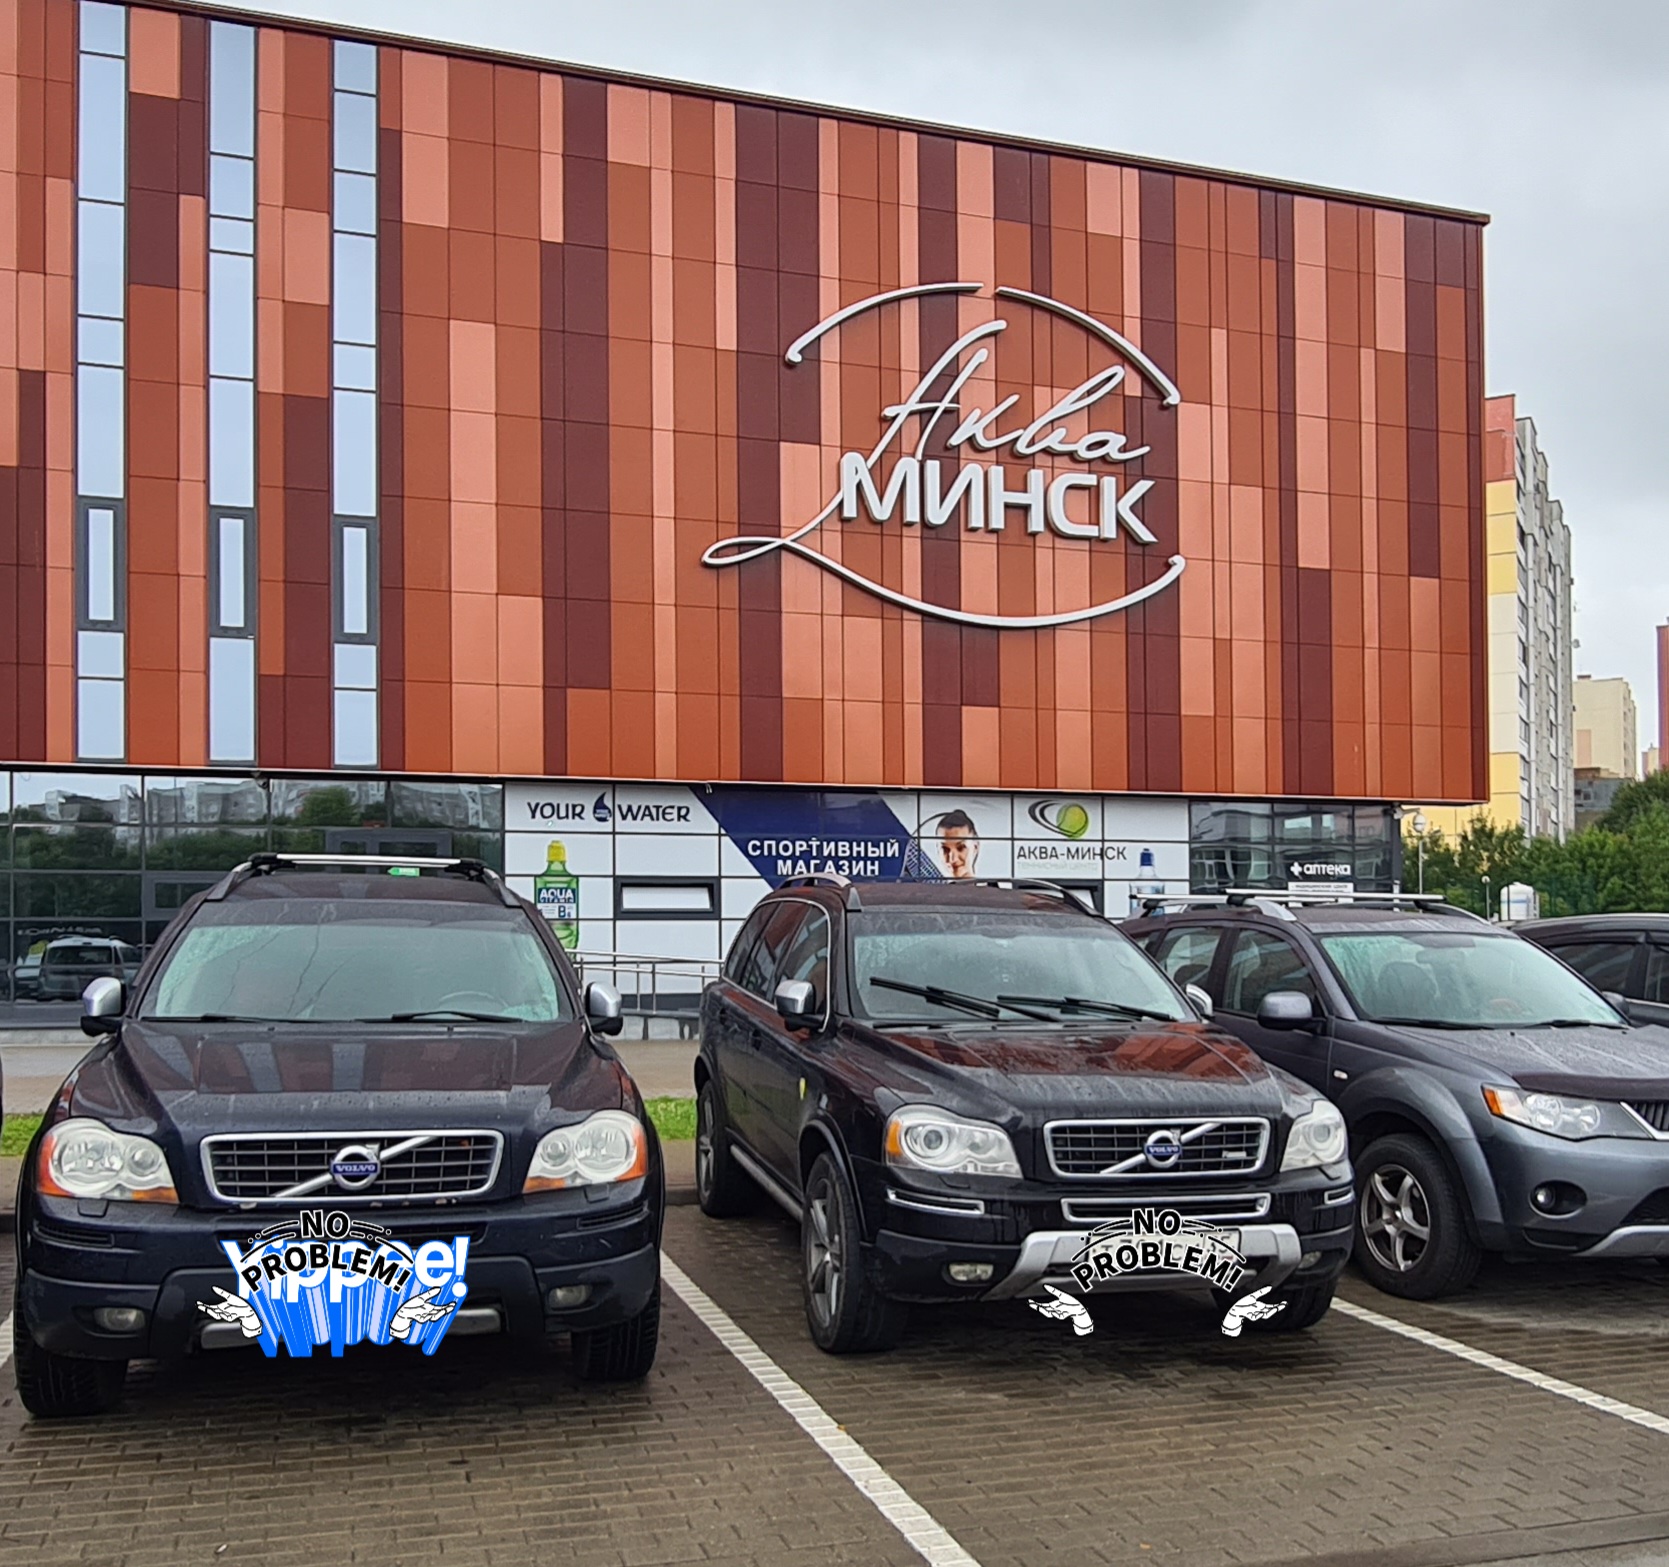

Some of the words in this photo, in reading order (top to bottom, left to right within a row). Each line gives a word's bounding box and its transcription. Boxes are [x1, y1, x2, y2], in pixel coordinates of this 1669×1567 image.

[839, 451, 1159, 544] МИНСК
[527, 802, 585, 820] YOUR
[617, 804, 690, 822] WATER
[747, 838, 899, 858] СПОРТИВНЫЙ
[1017, 846, 1127, 860] АКВА-МИНСК
[777, 859, 879, 876] МАГАЗИН
[540, 888, 574, 900] AQUA
[335, 1164, 376, 1172] VOLVO
